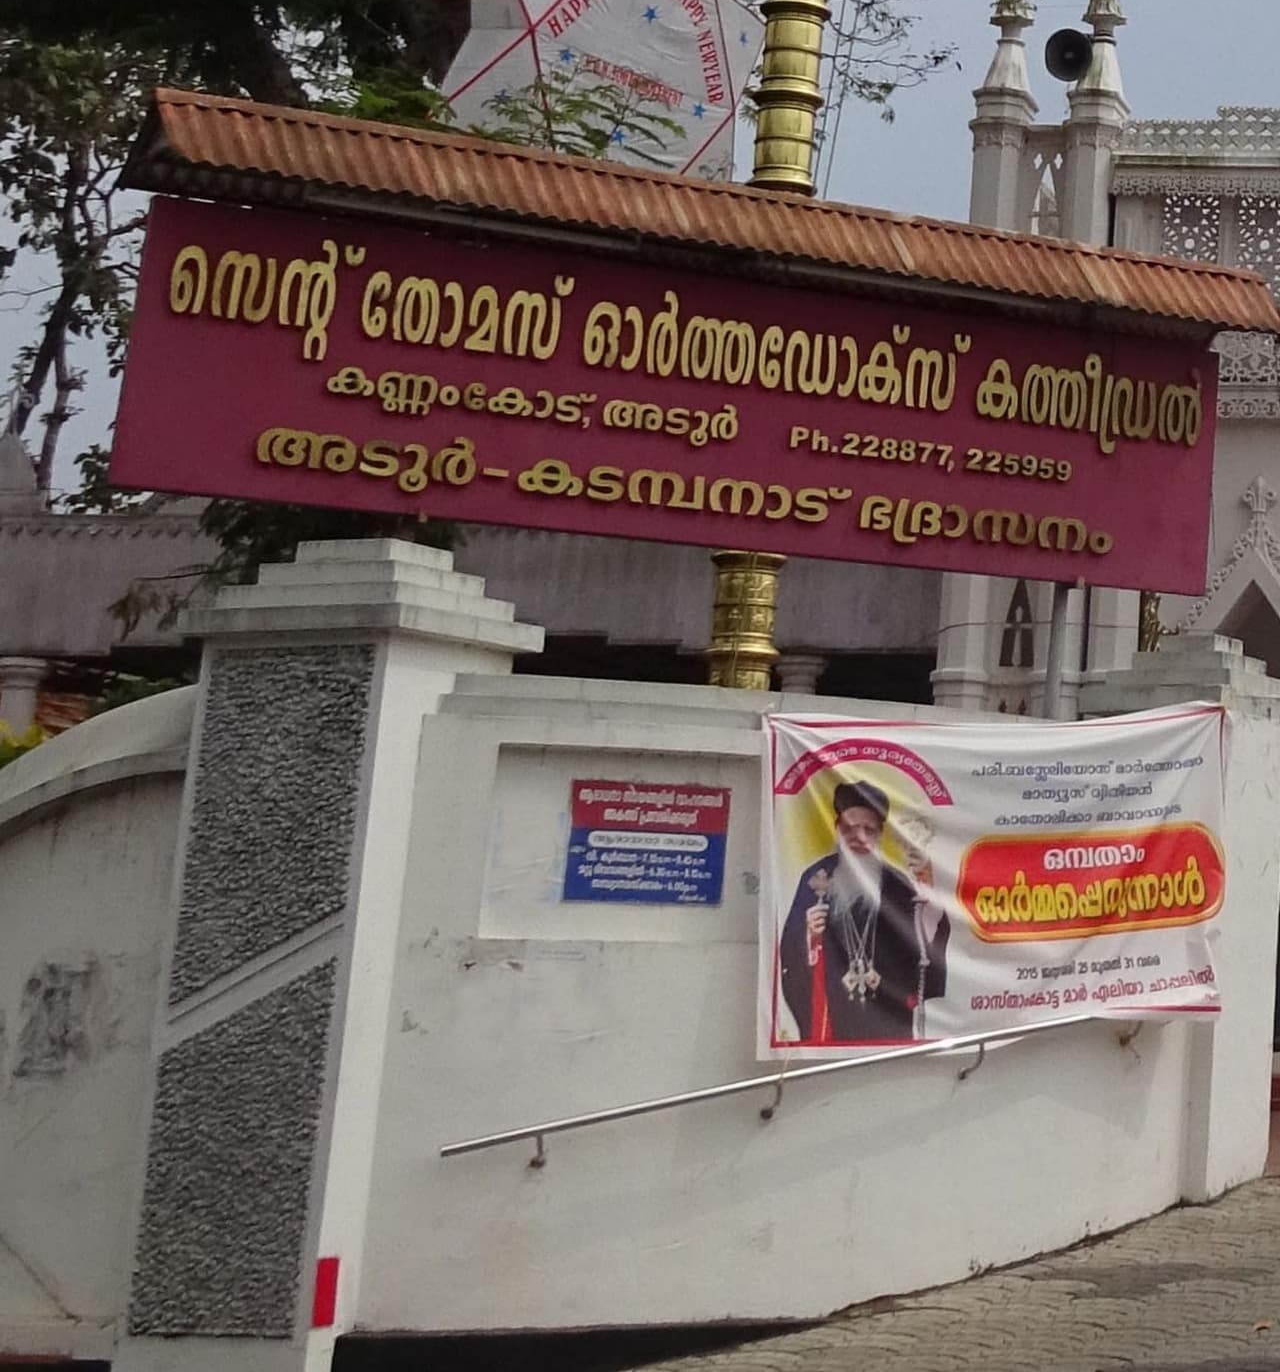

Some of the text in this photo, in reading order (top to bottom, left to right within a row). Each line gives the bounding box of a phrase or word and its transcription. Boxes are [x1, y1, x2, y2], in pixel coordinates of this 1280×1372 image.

[361, 271, 575, 361] തോമസ്
[603, 398, 739, 447] അടൂർ
[966, 448, 1073, 482] 225959
[859, 494, 1114, 555] ഭദ്രാസനം
[1043, 843, 1145, 870] ഒമ്പതാം
[975, 855, 1206, 923] ഓർമ്മപ്പെരുന്നാൾ
[1063, 983, 1088, 1004] മാർ
